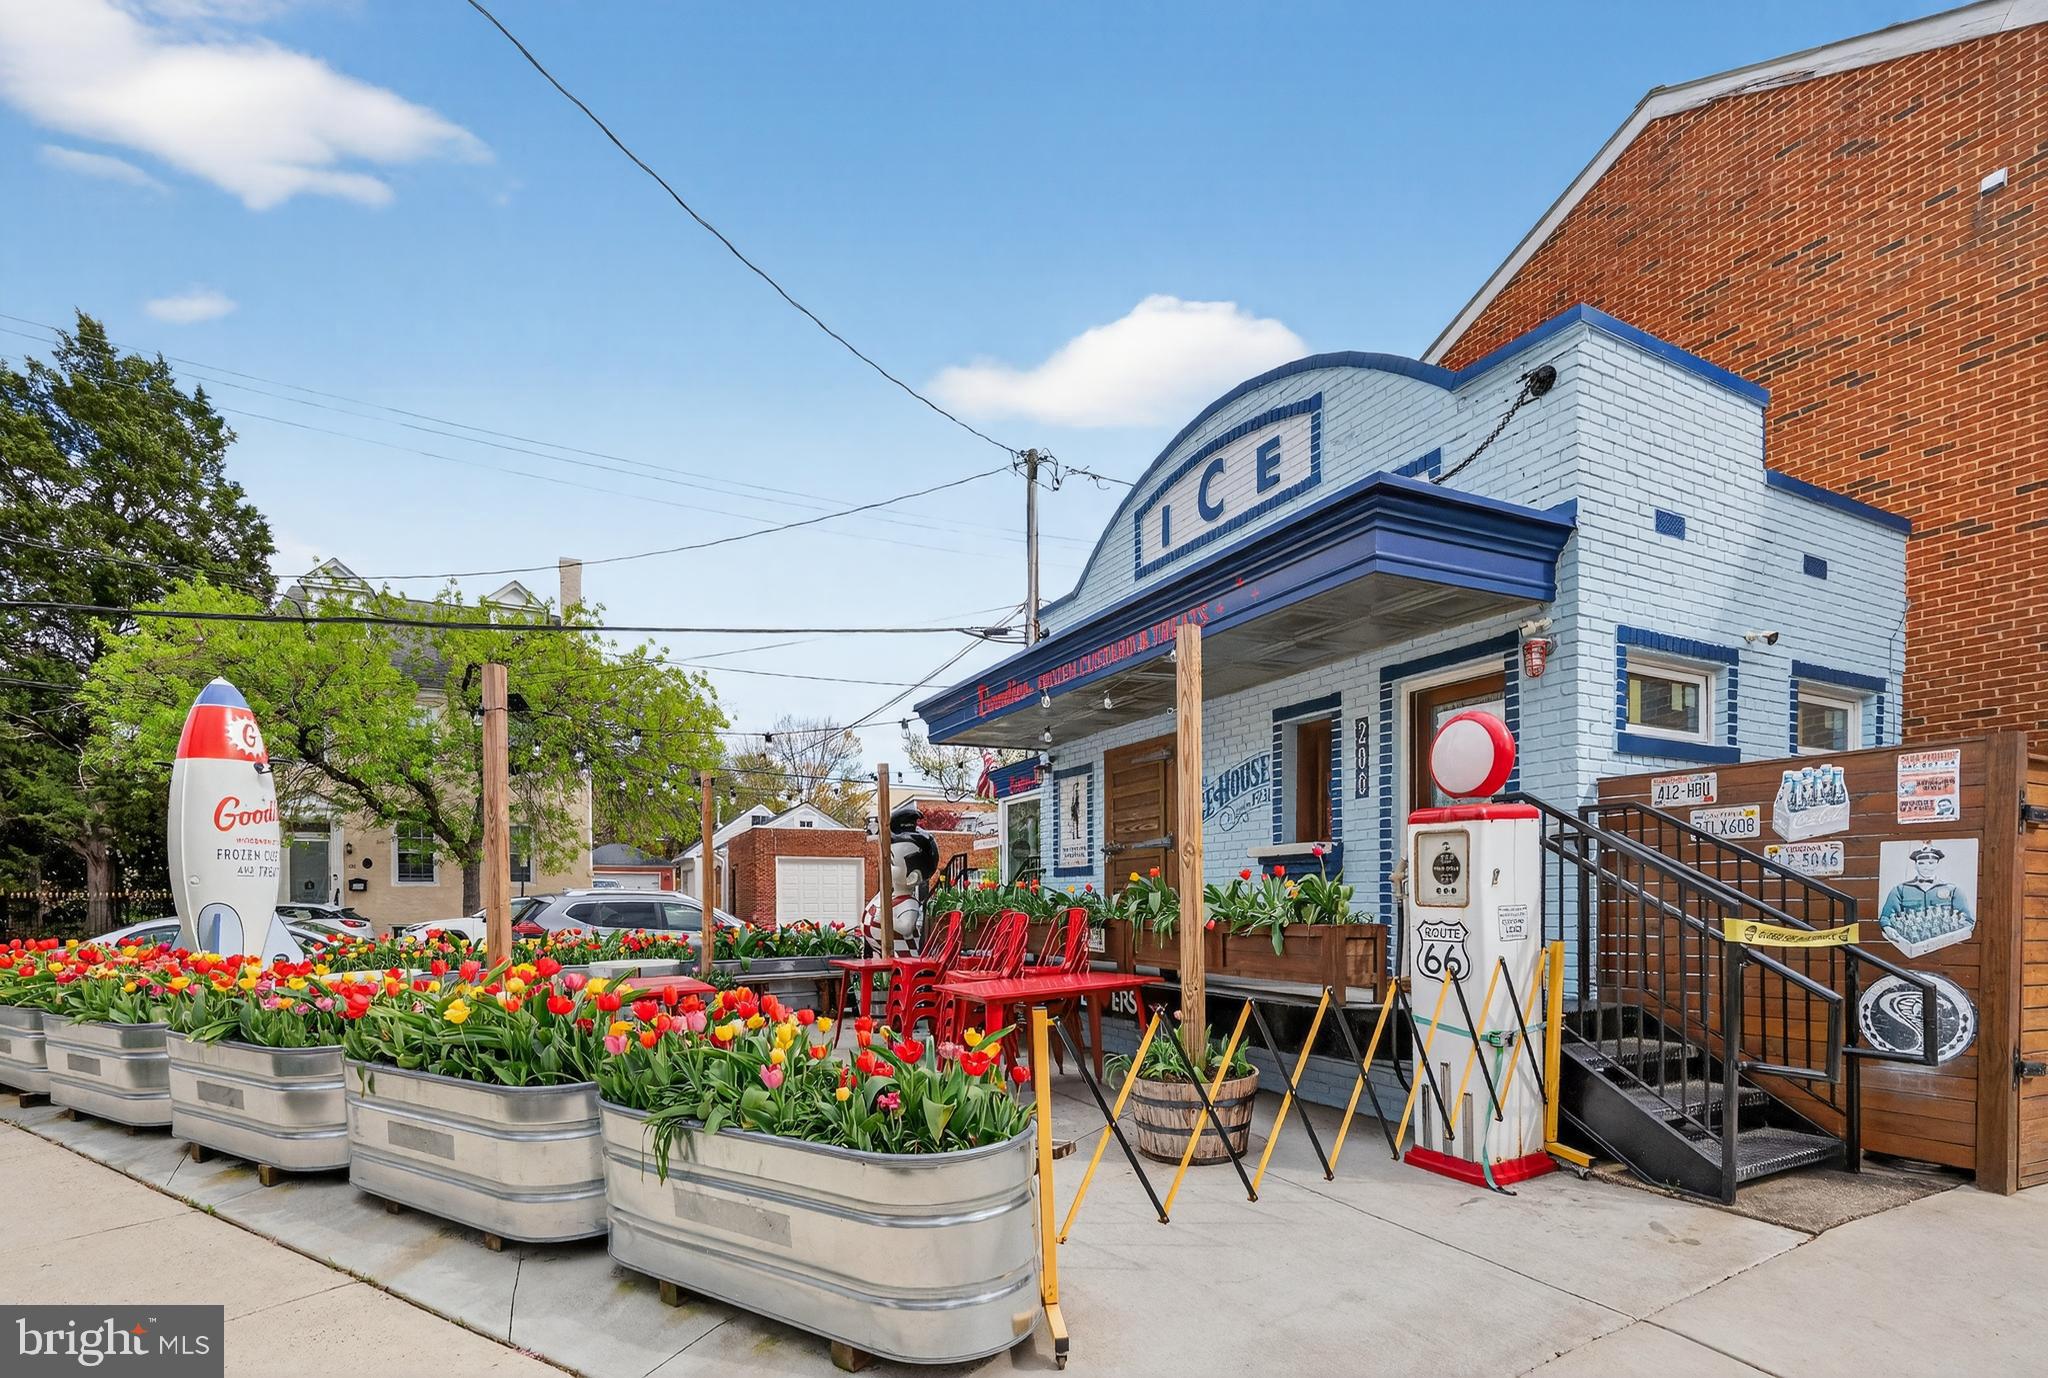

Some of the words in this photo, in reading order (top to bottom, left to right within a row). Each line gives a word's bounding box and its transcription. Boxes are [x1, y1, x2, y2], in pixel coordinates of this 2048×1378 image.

[1162, 435, 1280, 548] ICE
[242, 724, 256, 747] G
[1356, 721, 1367, 795] 200
[1214, 754, 1271, 807] HOUSE
[217, 849, 261, 860] FROZEN
[1425, 927, 1461, 939] ROUTE
[1424, 943, 1462, 976] 66
